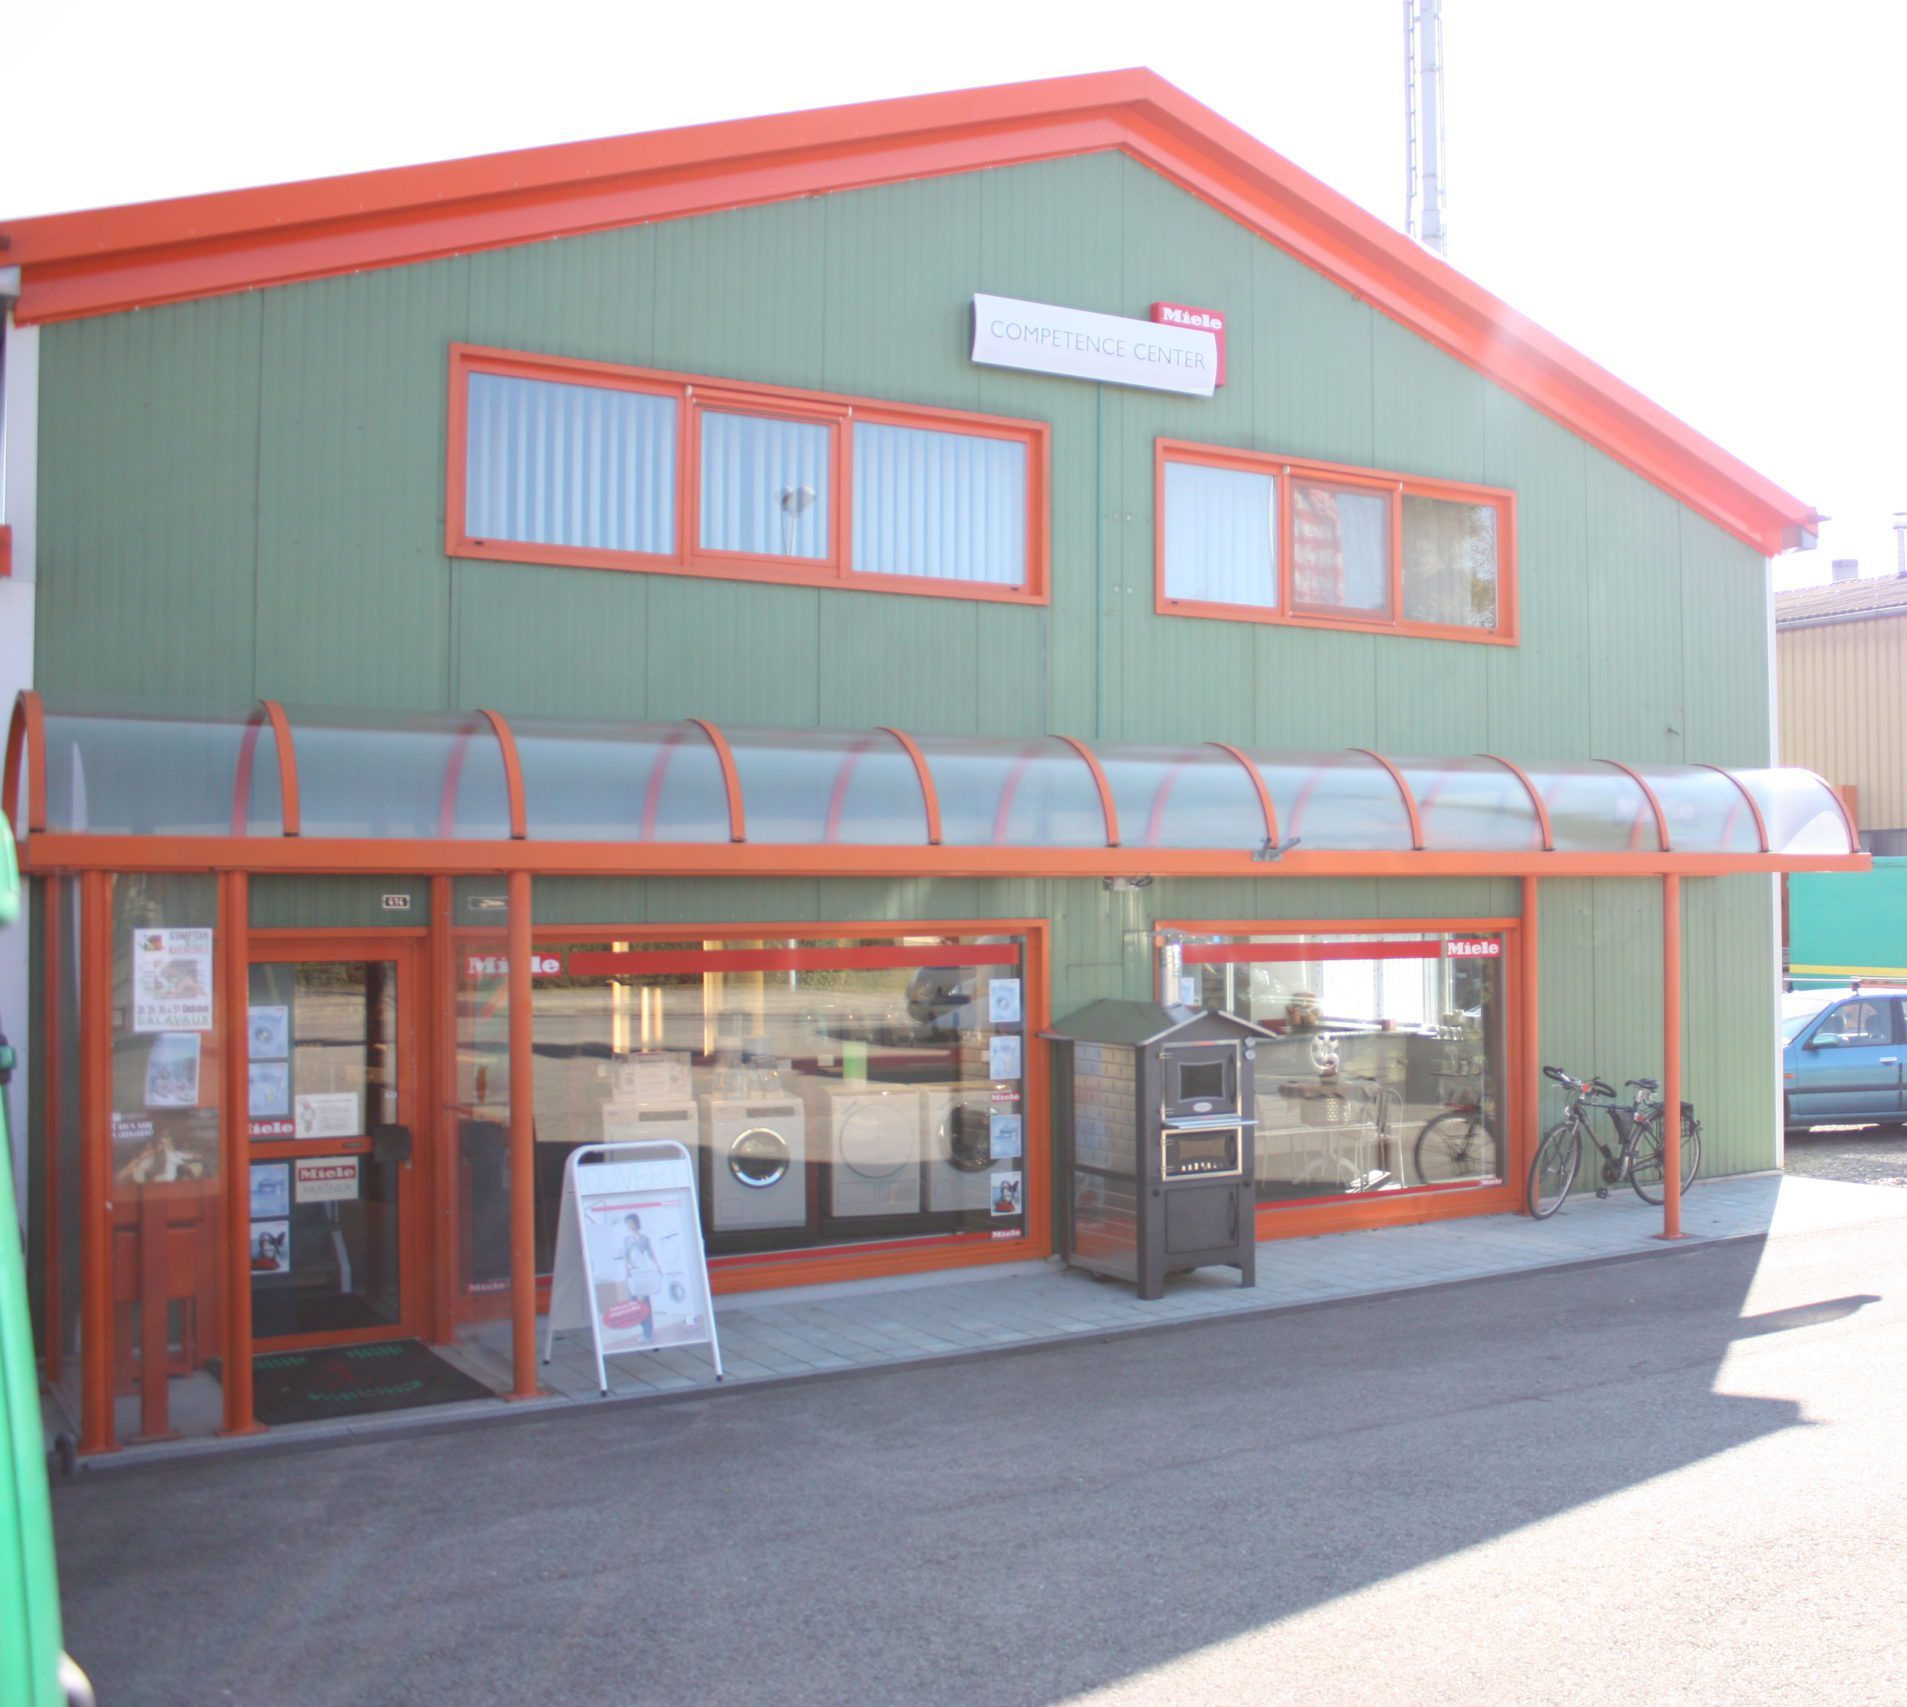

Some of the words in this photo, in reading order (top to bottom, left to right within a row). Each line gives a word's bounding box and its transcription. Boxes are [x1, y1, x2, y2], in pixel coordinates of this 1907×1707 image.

[1162, 306, 1223, 330] Miele
[990, 319, 1126, 358] COMPETENCE
[1133, 342, 1206, 371] CENTER
[1447, 941, 1500, 956] Miele
[467, 955, 560, 974] Mile
[137, 1014, 210, 1026] SALAVAUX
[991, 1092, 1021, 1102] Miele
[248, 1121, 294, 1135] iele
[299, 1166, 355, 1180] Miele
[586, 1161, 684, 1190] OUVERT
[302, 1182, 353, 1194] PARTNER
[992, 1229, 1022, 1239] Miele
